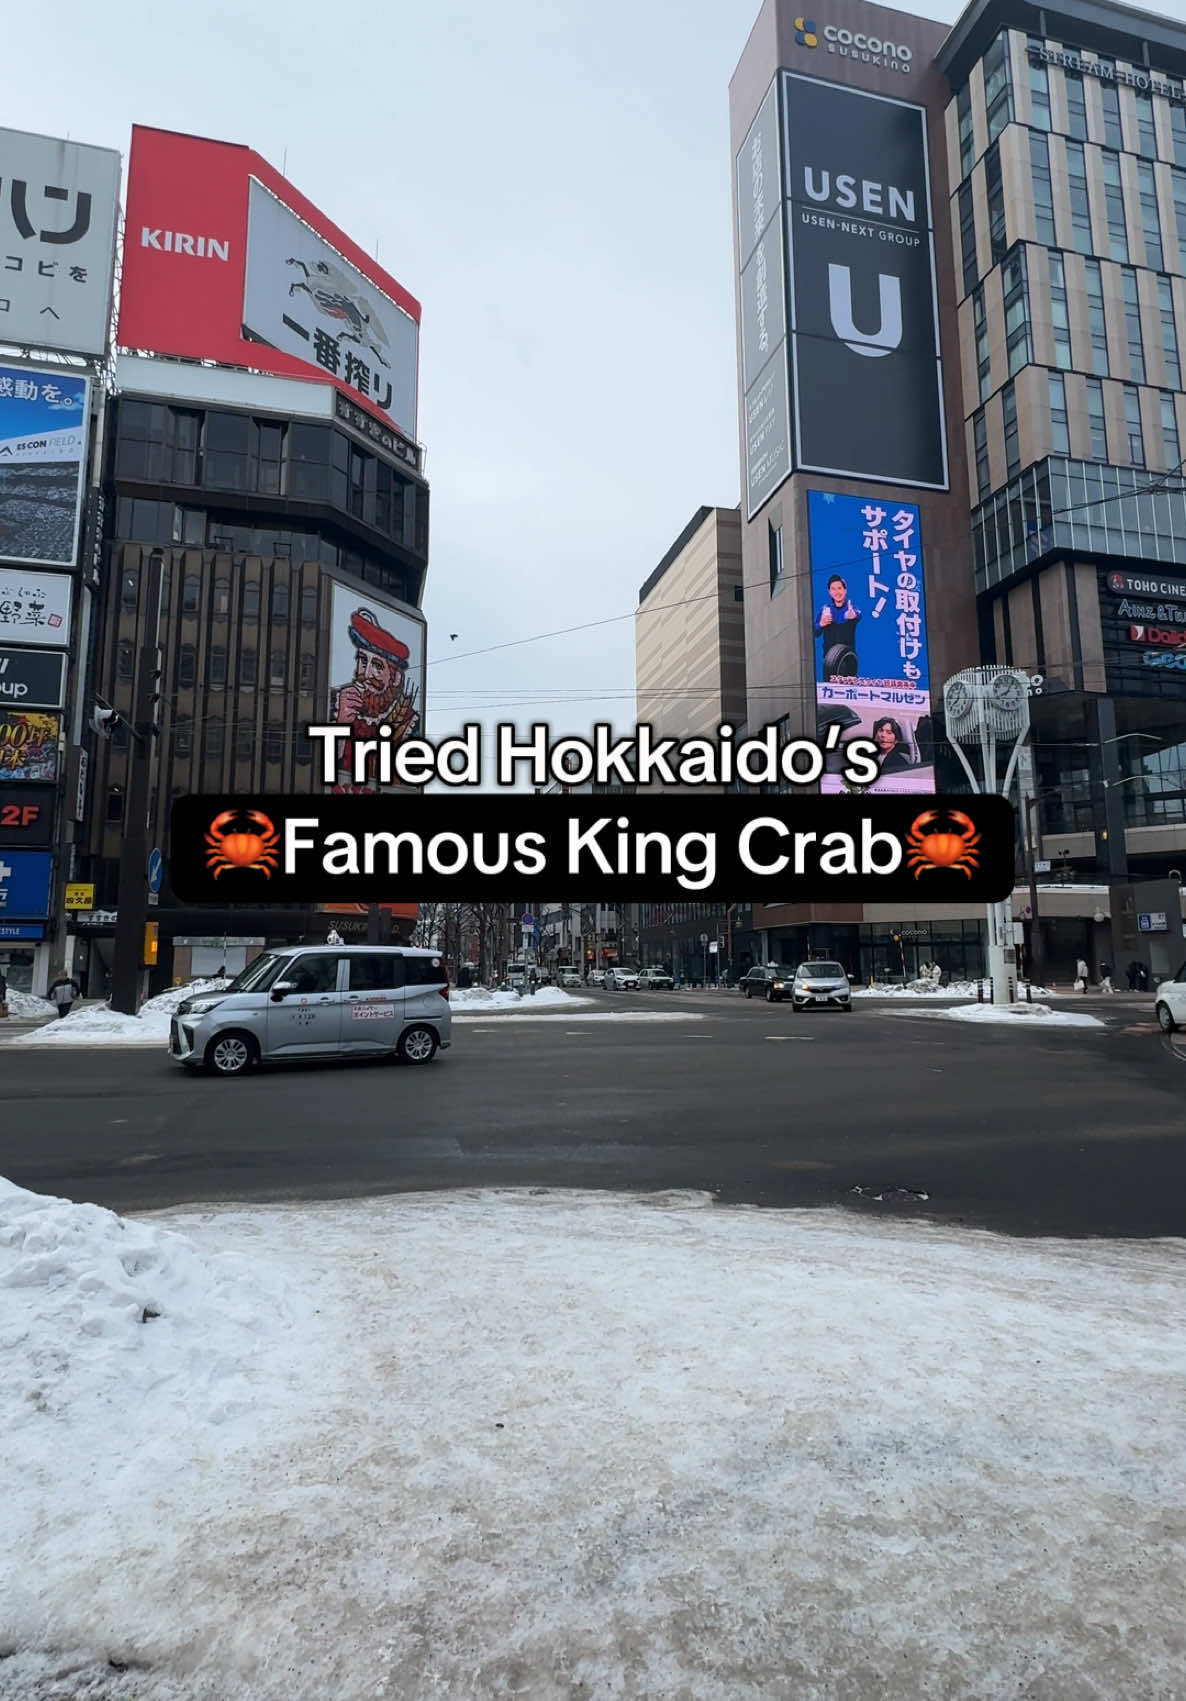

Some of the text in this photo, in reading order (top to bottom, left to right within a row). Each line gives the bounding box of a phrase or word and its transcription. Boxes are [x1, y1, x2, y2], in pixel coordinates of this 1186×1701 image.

[1039, 47, 1181, 99] STREAM HOTEL
[804, 166, 916, 222] USEN
[140, 226, 230, 262] KIRIN
[801, 212, 921, 248] USEN-NEXT GROUP
[828, 263, 903, 358] U
[282, 312, 393, 410] 一番搾り
[891, 509, 922, 680] タイヤの取付けも
[1126, 578, 1186, 597] TOHO CINE
[1, 805, 39, 826] 2F
